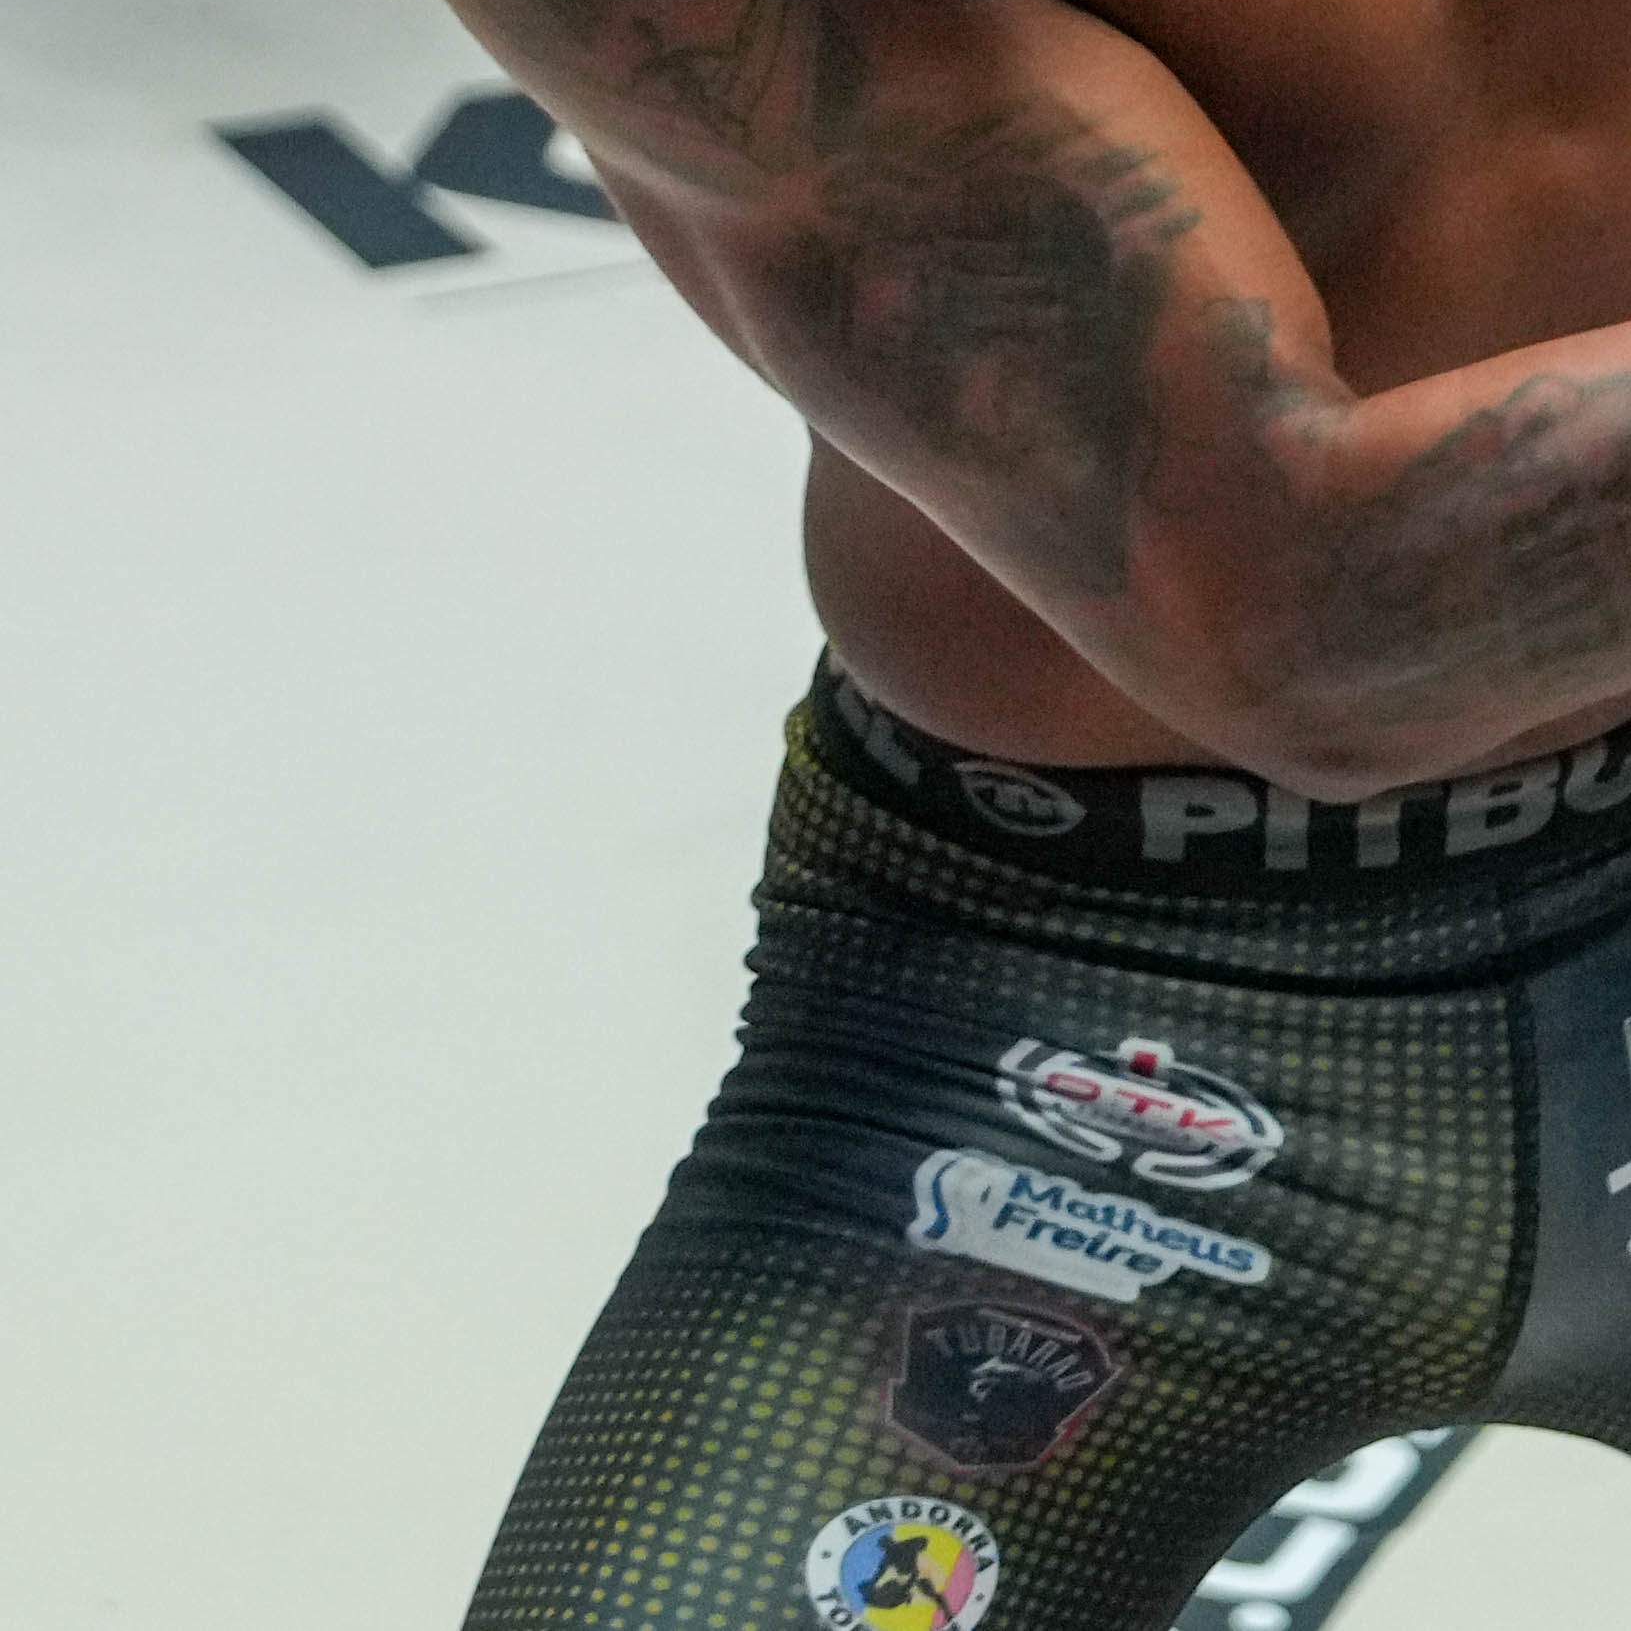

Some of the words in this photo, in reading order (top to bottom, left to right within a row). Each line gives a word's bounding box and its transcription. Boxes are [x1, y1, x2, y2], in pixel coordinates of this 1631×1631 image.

[992, 1200, 1164, 1275] Freire
[1008, 1171, 1255, 1274] Matheus
[843, 1499, 996, 1574] ANDORRA
[815, 1586, 872, 1631] TO
